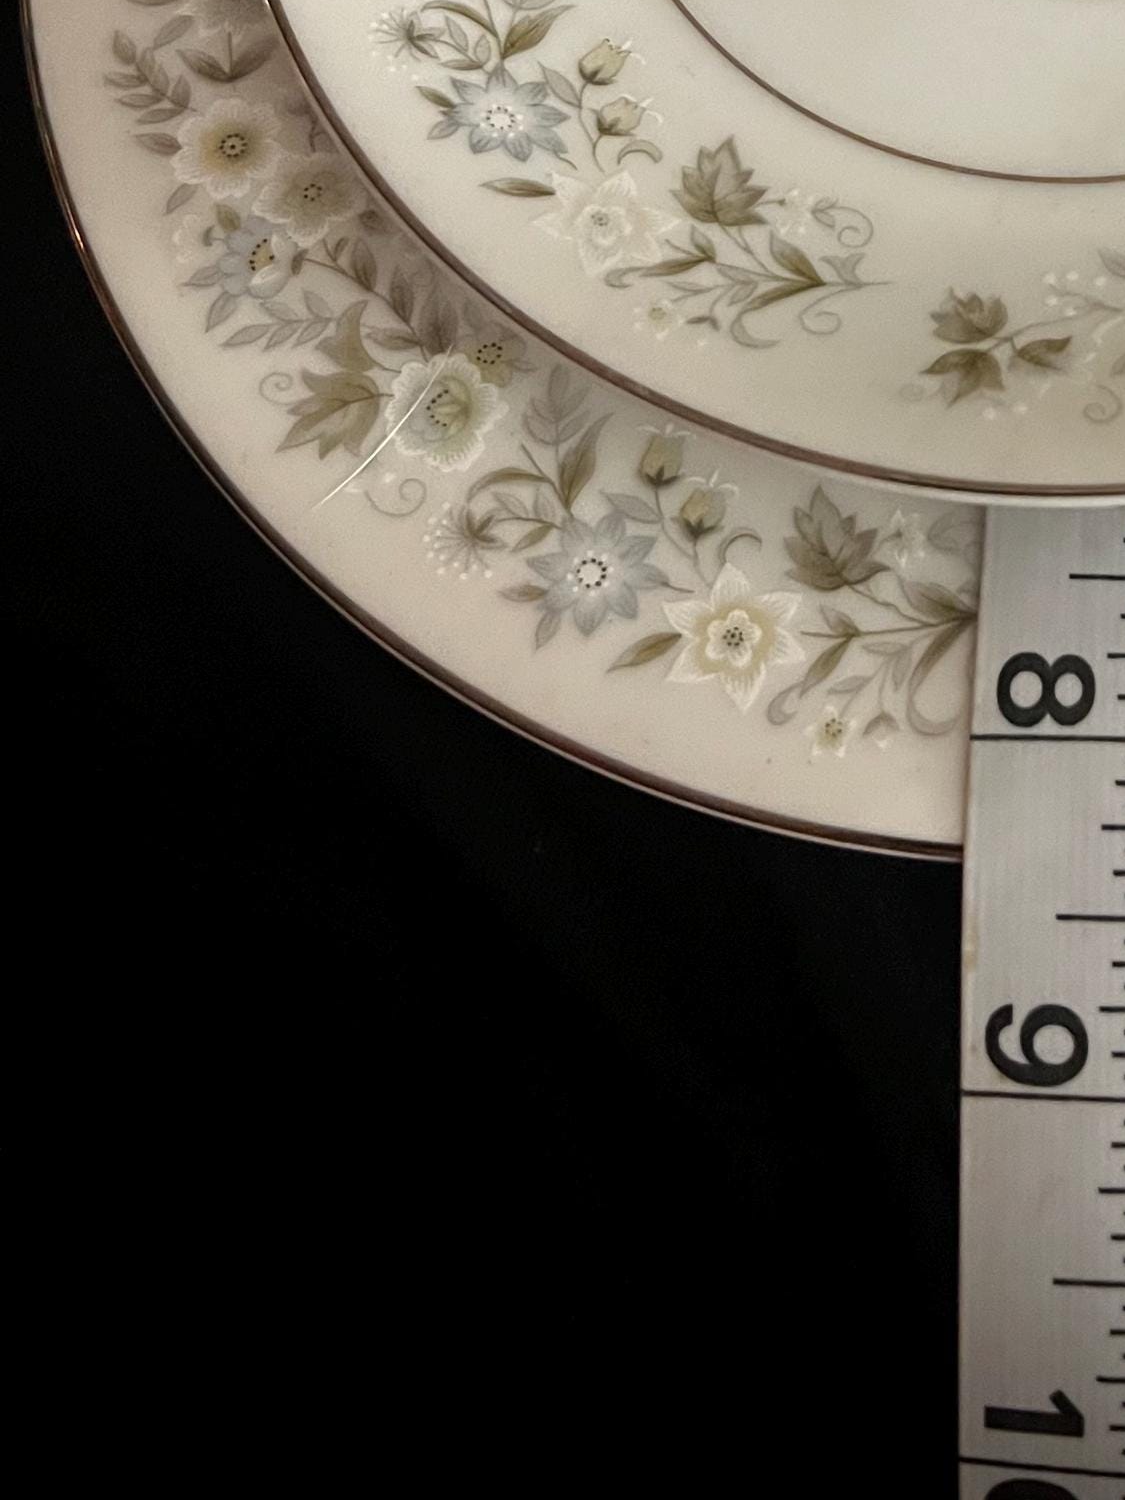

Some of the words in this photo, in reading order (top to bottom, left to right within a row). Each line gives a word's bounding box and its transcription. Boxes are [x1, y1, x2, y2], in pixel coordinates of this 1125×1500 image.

[997, 652, 1095, 727] 8
[985, 1004, 1088, 1087] 9
[984, 1390, 1084, 1500] 1
